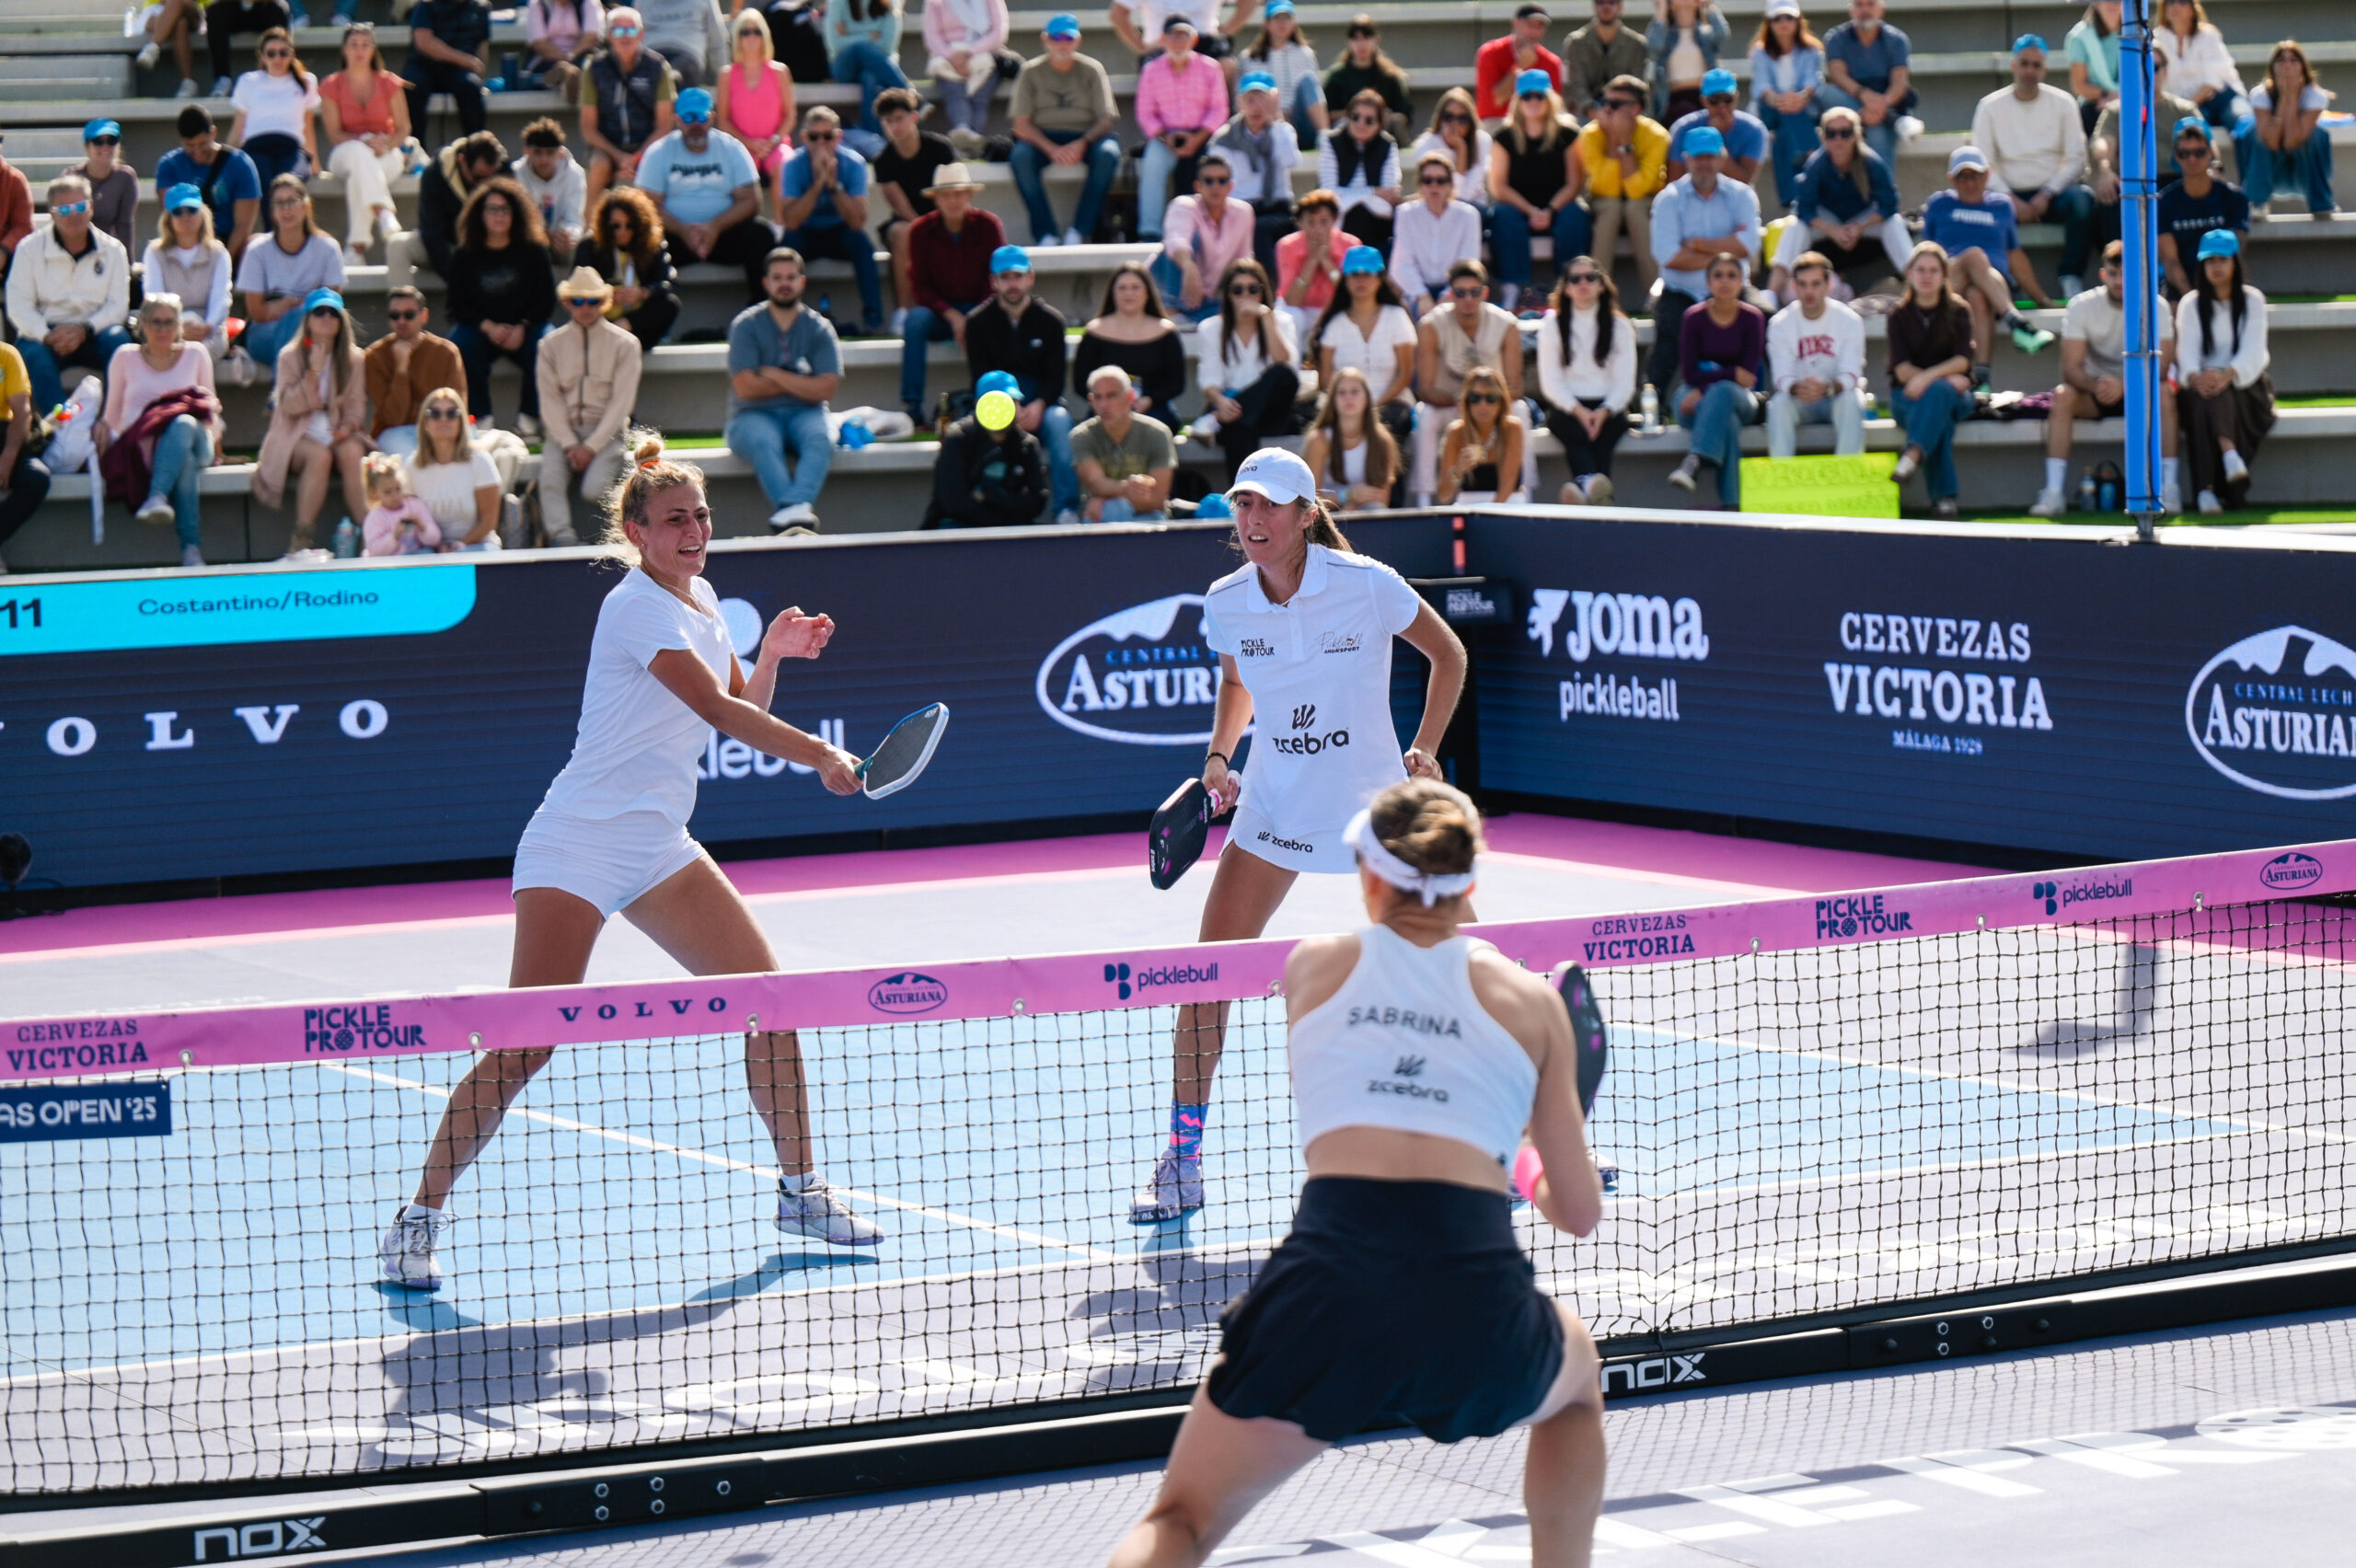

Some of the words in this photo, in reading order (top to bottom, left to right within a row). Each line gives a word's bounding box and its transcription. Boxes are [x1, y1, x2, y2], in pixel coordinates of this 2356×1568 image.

[138, 589, 379, 616] Costantino/Rodino
[1241, 639, 1265, 649] PICKLE
[1841, 612, 2032, 663] CERVEZAS
[1105, 646, 1200, 664] CENTRAL
[1560, 671, 1680, 722] pickleball
[1824, 663, 2054, 731] VICTORIA
[2235, 682, 2305, 703] CENTRAL
[2311, 687, 2356, 707] LECH
[0, 699, 389, 757] OLVO
[1272, 730, 1350, 755] zcebra
[1892, 729, 1952, 754] MÁLAGA
[1271, 836, 1313, 853] zcebra
[2265, 868, 2318, 883] ASTURIANA
[2063, 879, 2132, 908] picklebull
[1816, 894, 1885, 920] PICKLE
[1592, 914, 1687, 936] CERVEZAS
[1583, 933, 1696, 962] VICTORIA
[1138, 963, 1218, 992] picklebull
[557, 997, 727, 1022] VOLVO
[874, 989, 943, 1005] ASTURIANA
[17, 1019, 138, 1043] CERVEZAS
[304, 1005, 391, 1031] PICKLE
[1347, 1006, 1462, 1040] SABRINA
[6, 1042, 149, 1072] VICTORIA
[1367, 1079, 1450, 1103] zcebra
[40, 1098, 121, 1126] OPEN
